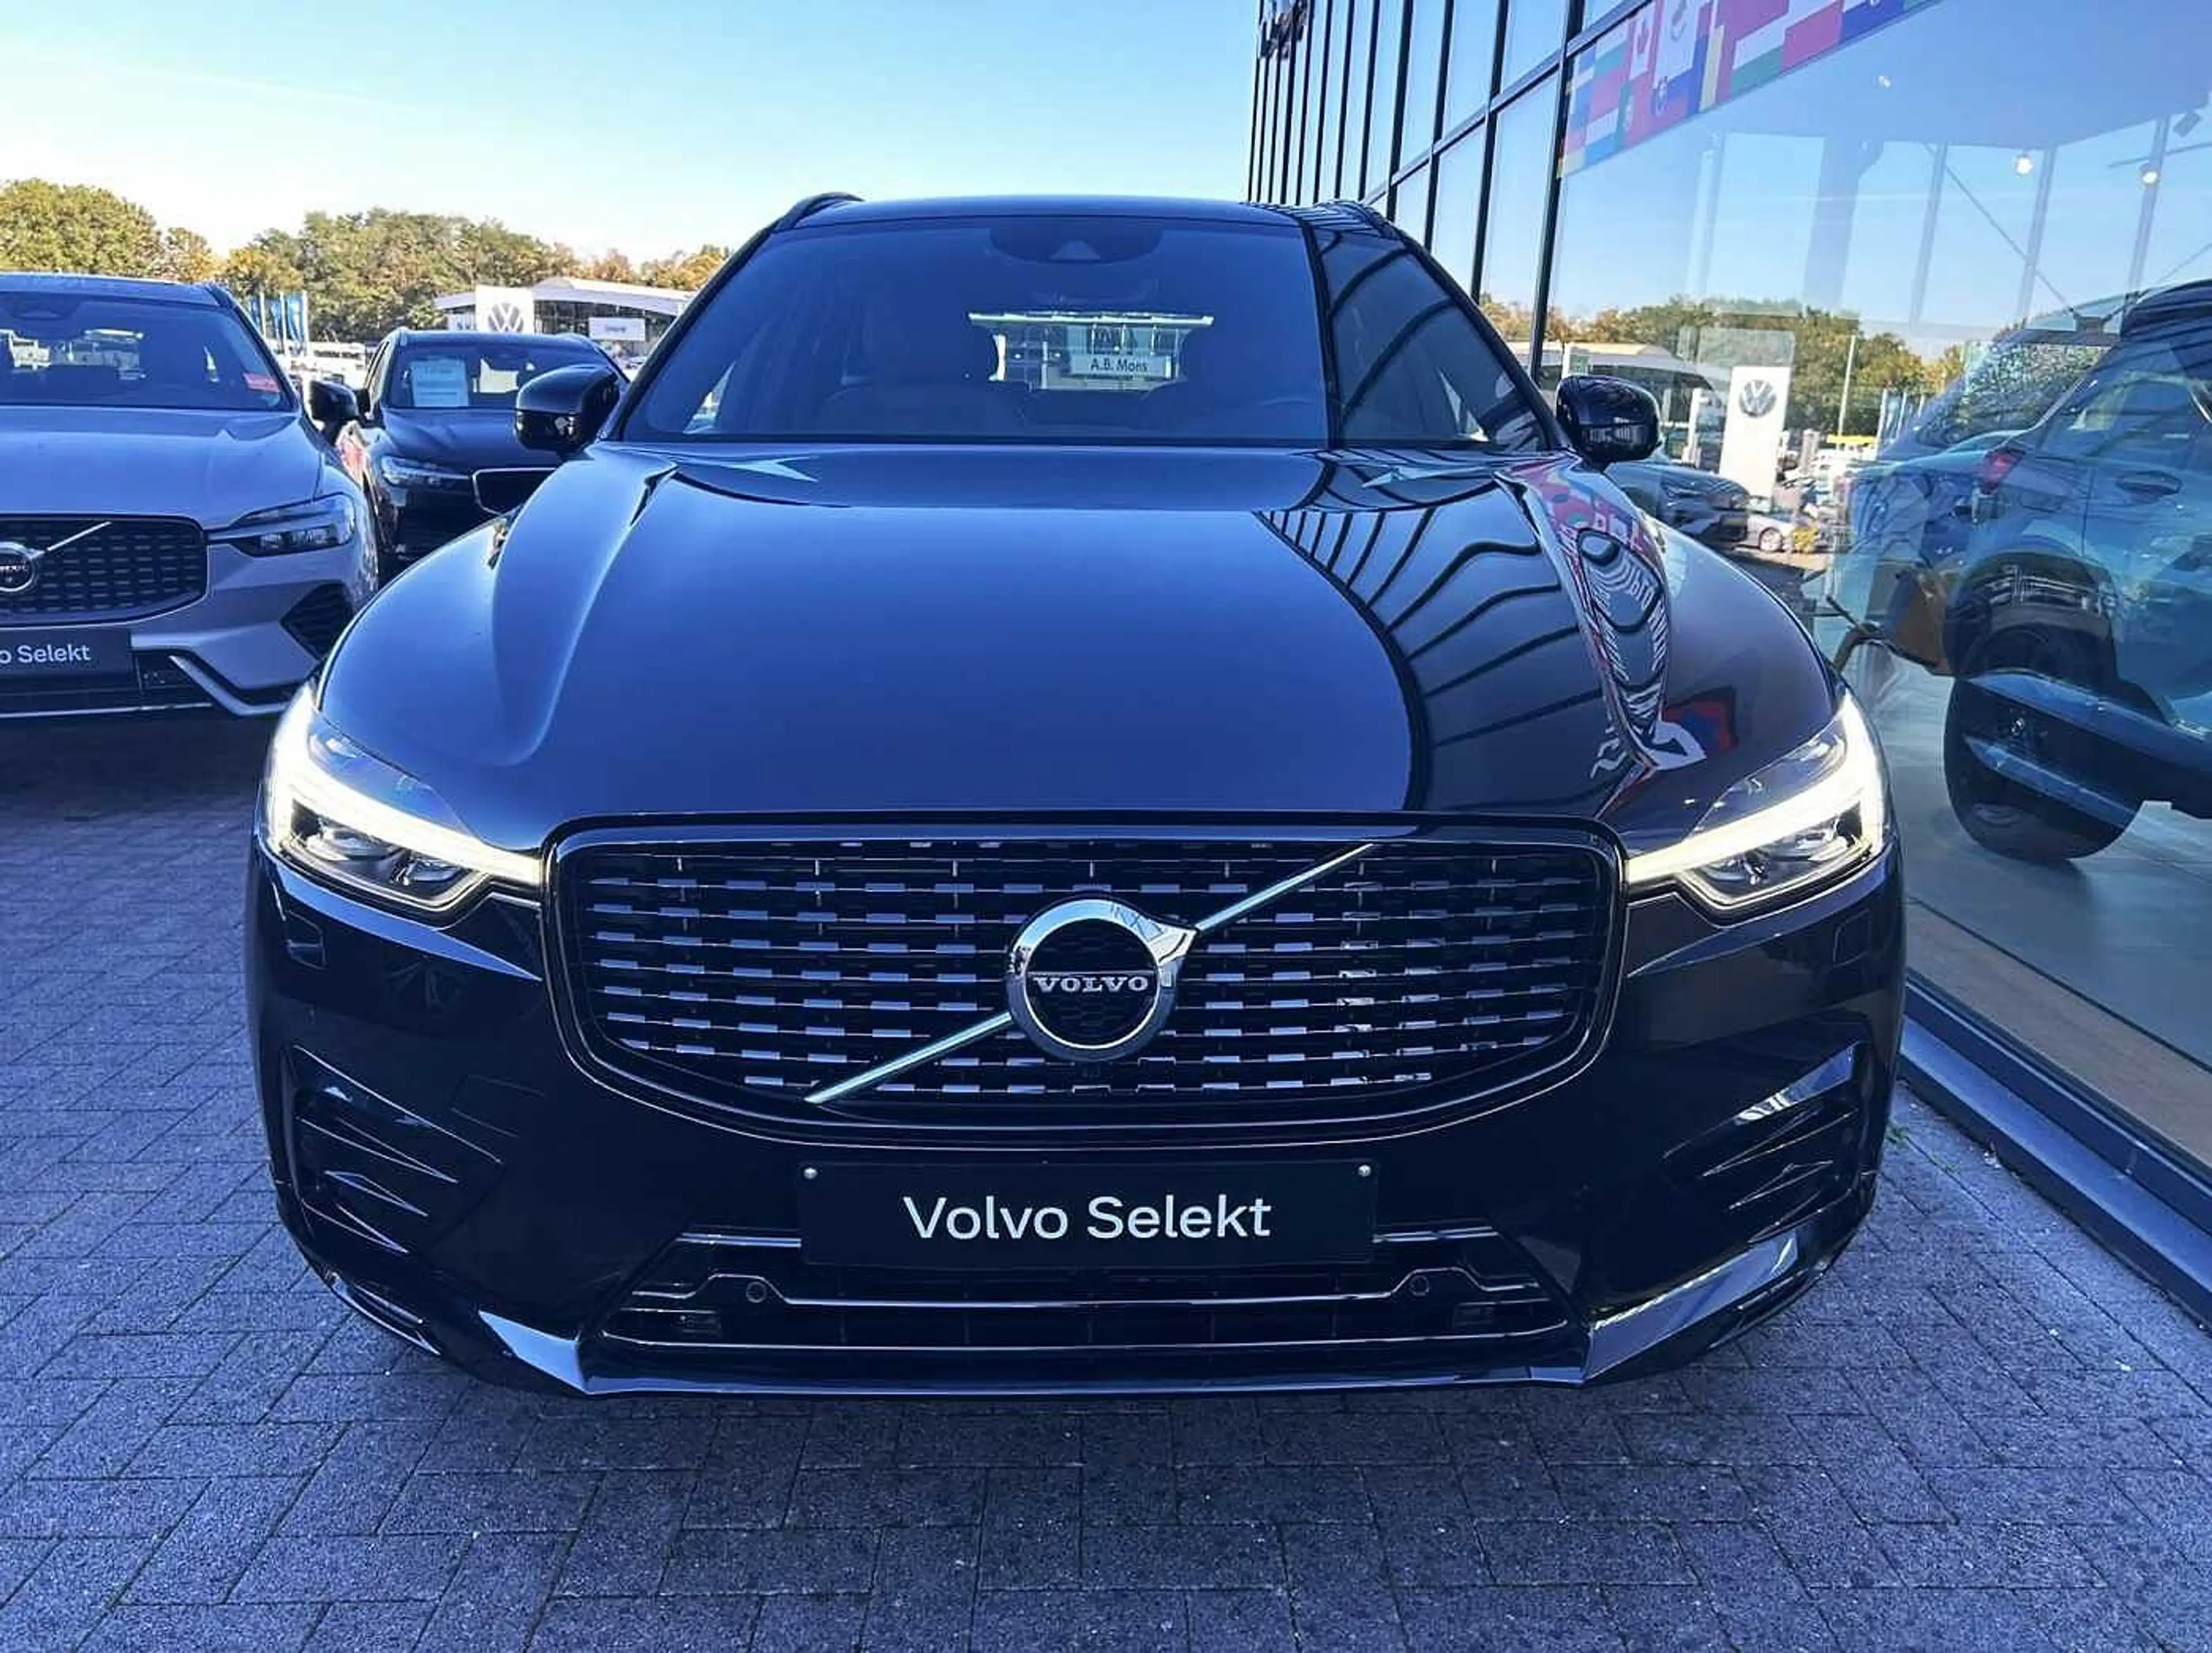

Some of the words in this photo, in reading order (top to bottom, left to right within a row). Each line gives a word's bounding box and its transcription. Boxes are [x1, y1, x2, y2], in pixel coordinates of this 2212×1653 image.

[17, 643, 91, 663] Selekt
[1033, 976, 1148, 992] VOLVO
[903, 1196, 1069, 1240] Volvo
[1087, 1194, 1271, 1239] Selekt
